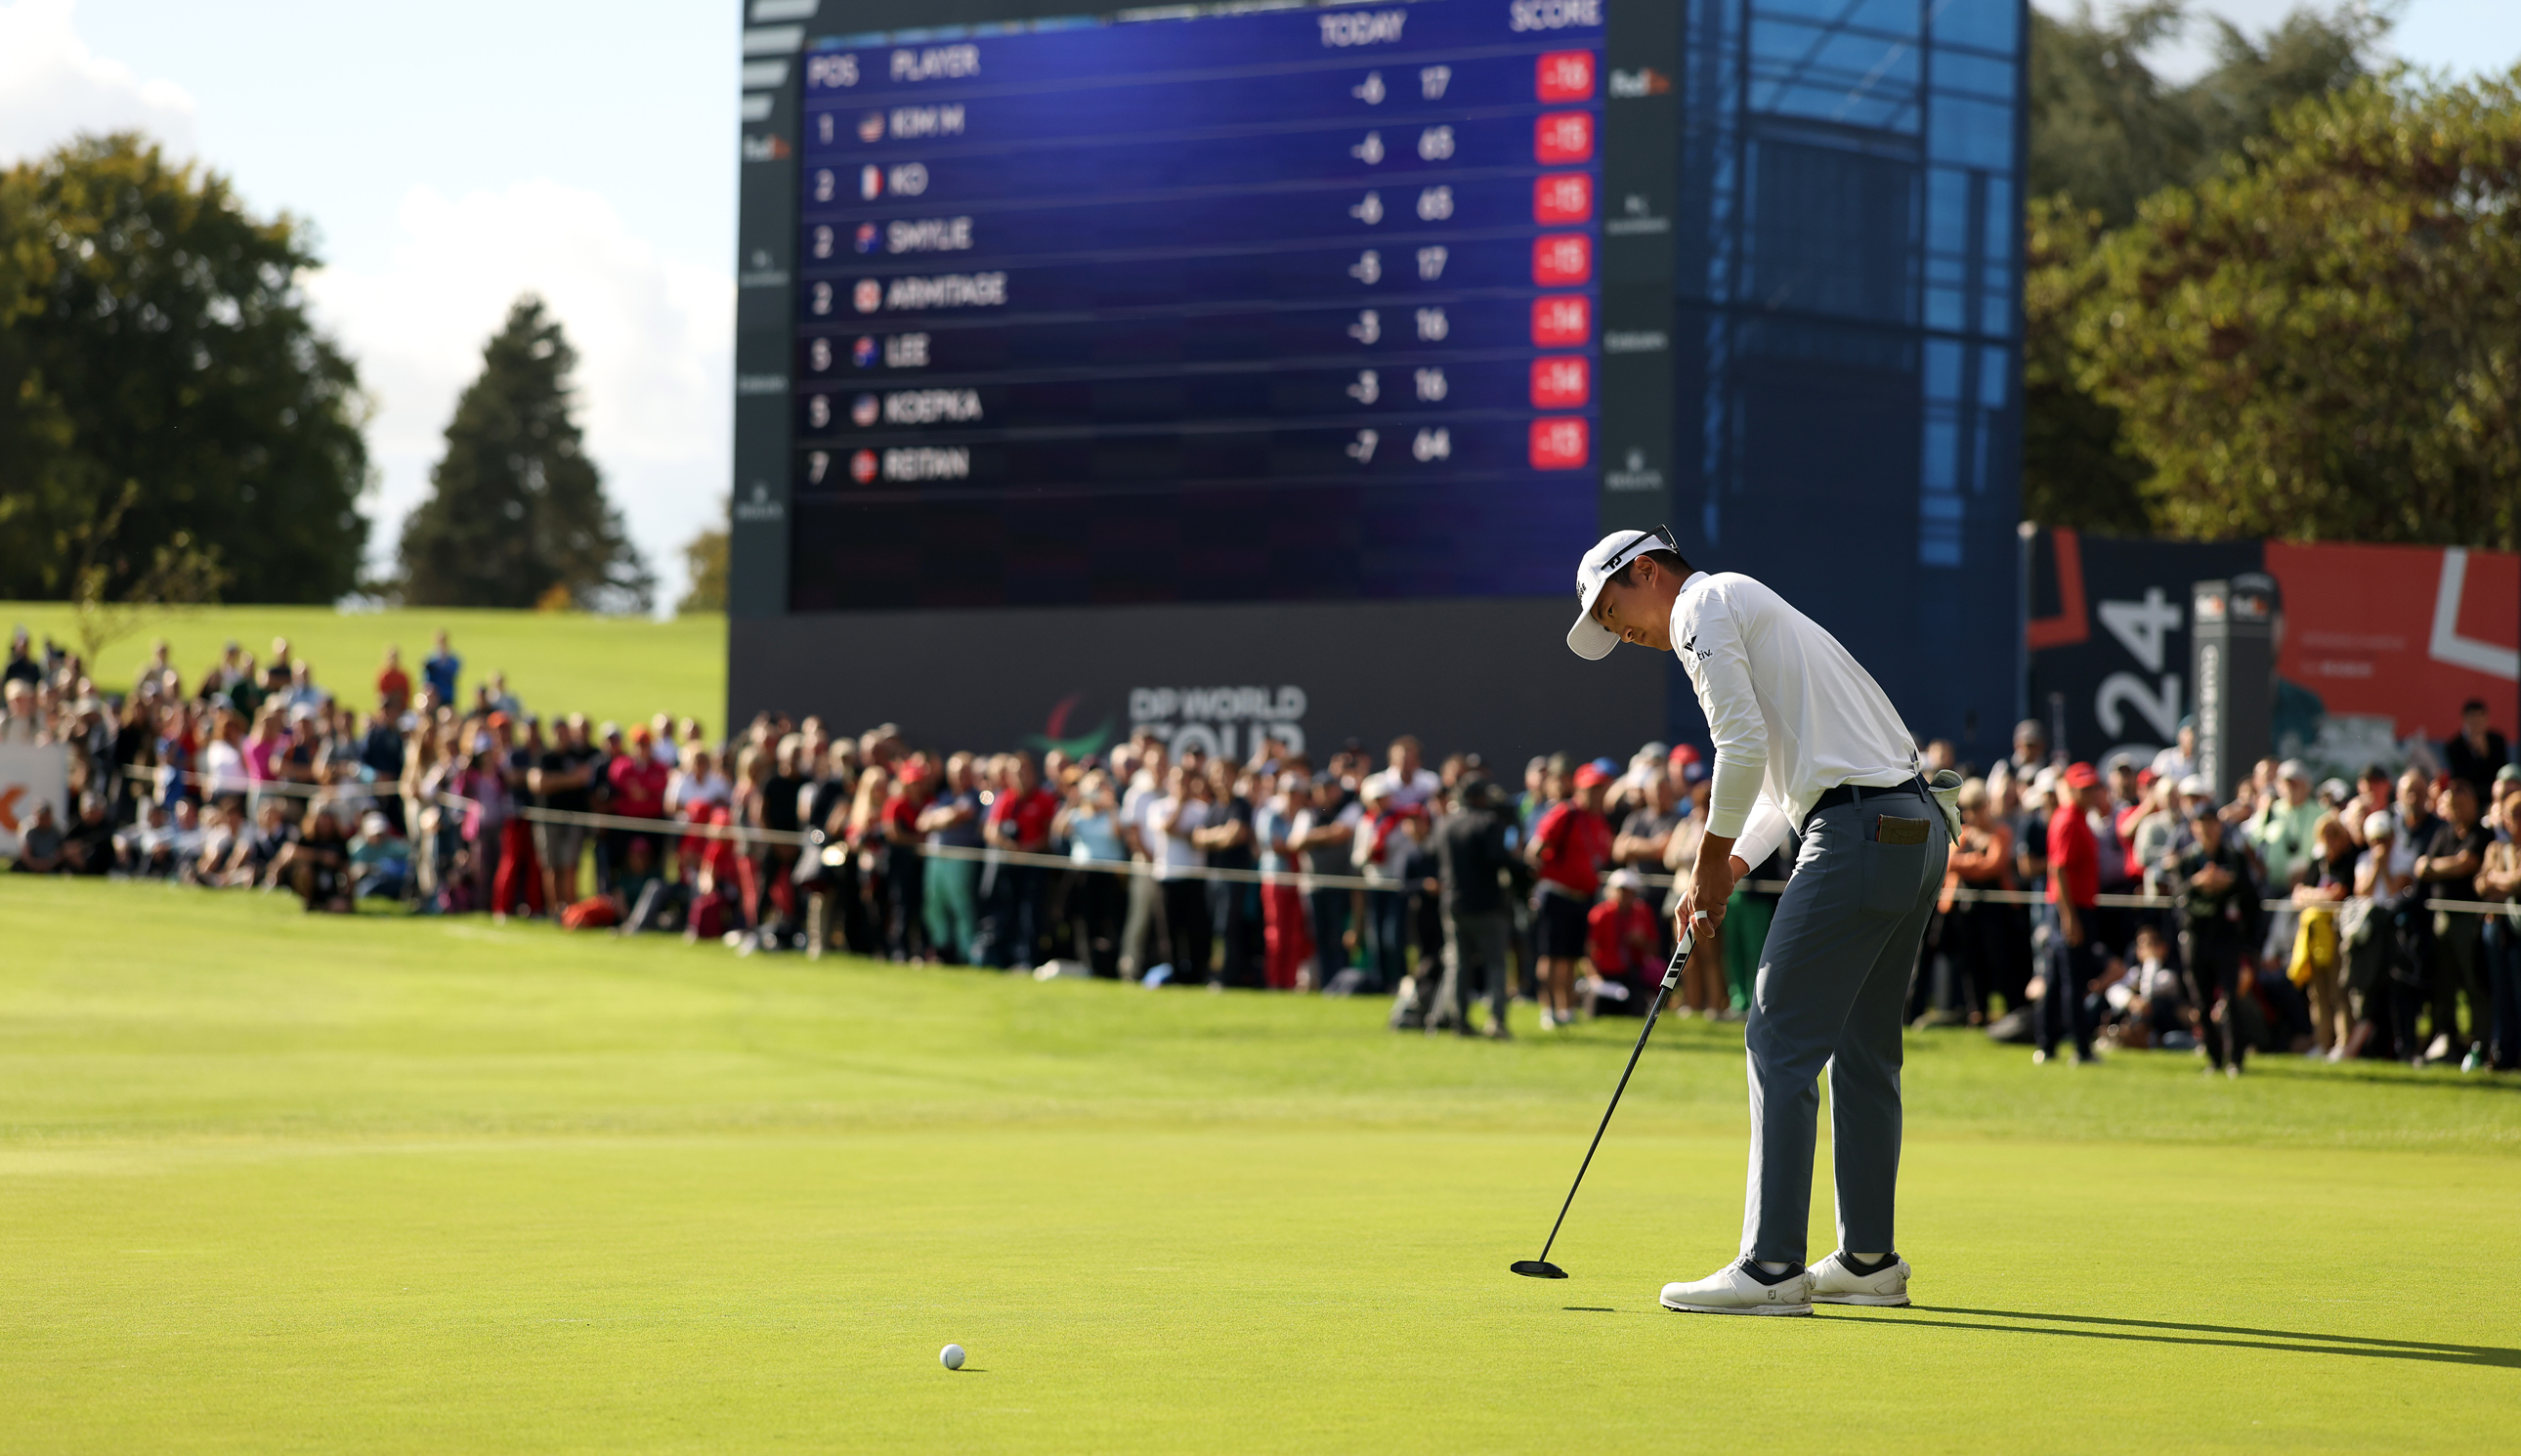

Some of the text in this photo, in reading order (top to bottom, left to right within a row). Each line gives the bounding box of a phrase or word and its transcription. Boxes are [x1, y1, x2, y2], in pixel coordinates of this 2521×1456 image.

[807, 0, 1602, 87] POS PLAYER TODAY SCORE
[817, 112, 835, 144] 1
[815, 169, 836, 202] 2
[889, 163, 928, 194] KO
[813, 226, 834, 259] 2
[887, 216, 973, 254] SMYLIE
[812, 281, 833, 316] 2
[886, 272, 1007, 309] ARMITAGE
[885, 332, 930, 367] LEE
[884, 389, 982, 424] KOEPKA
[809, 450, 830, 485] 7
[883, 446, 970, 482] REITAN
[1129, 685, 1306, 721] DP WORLD
